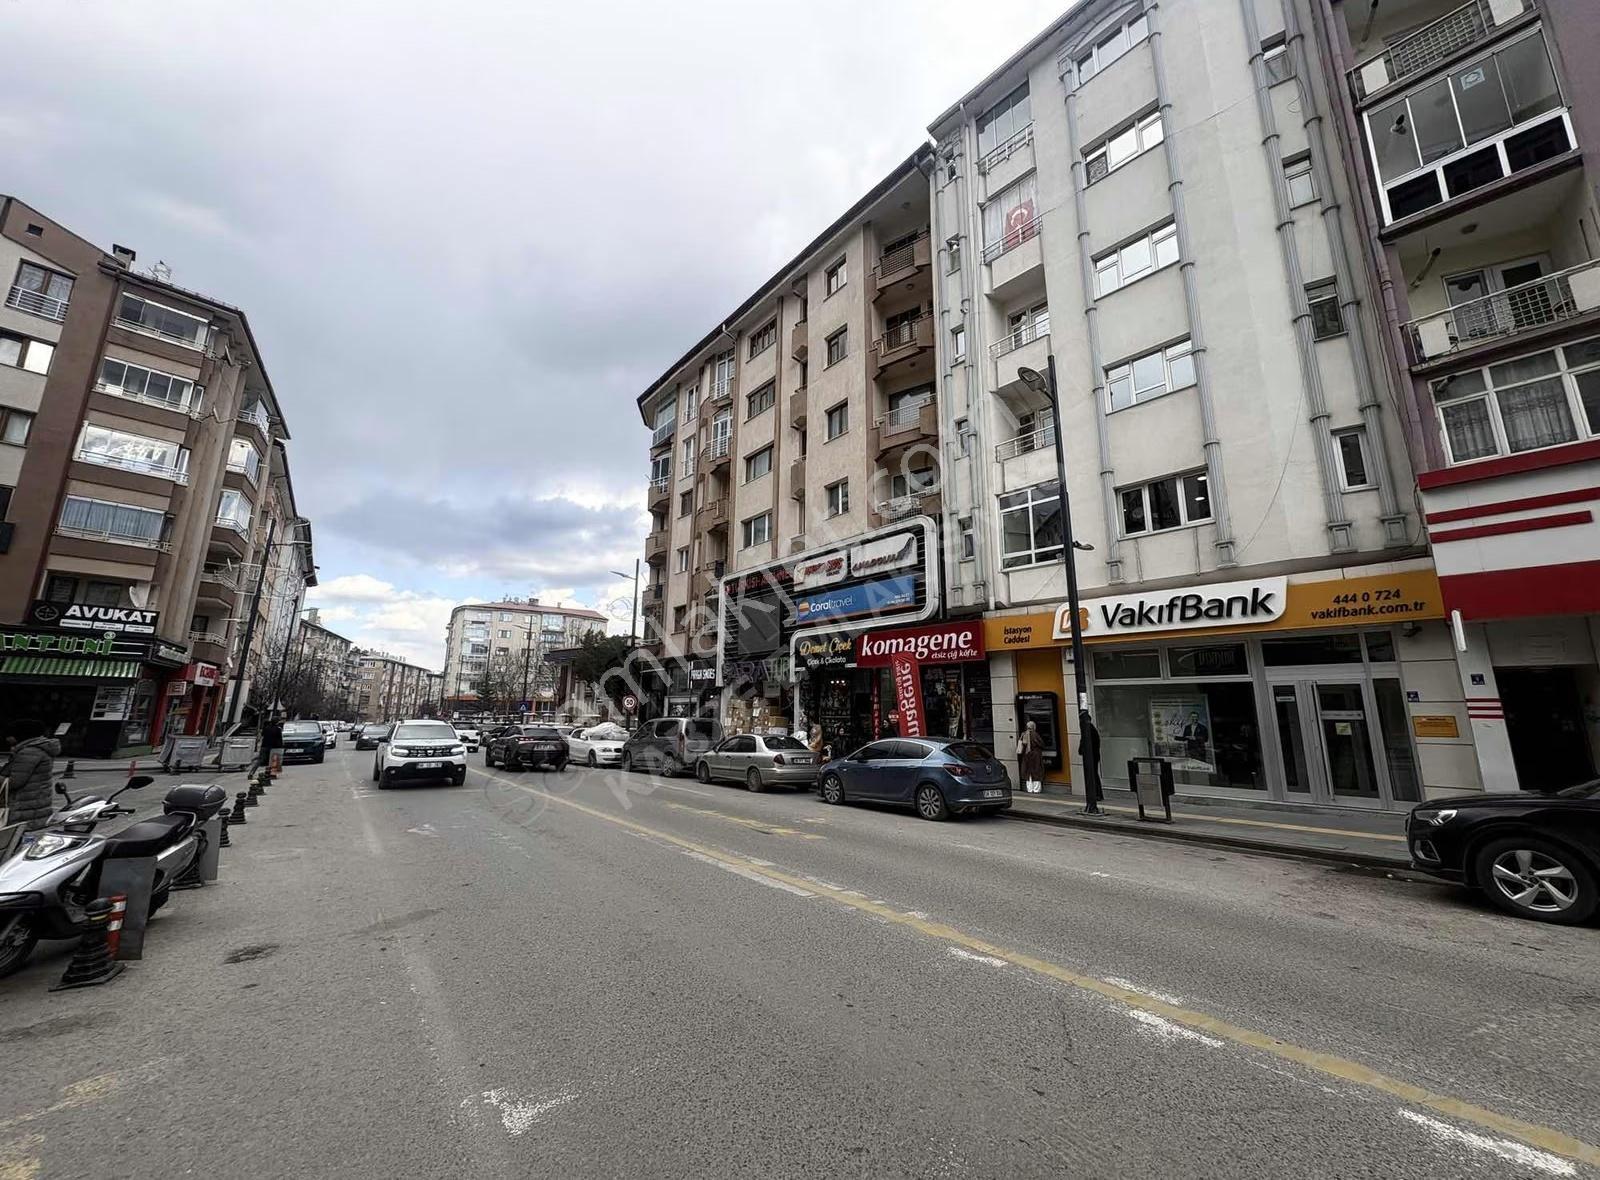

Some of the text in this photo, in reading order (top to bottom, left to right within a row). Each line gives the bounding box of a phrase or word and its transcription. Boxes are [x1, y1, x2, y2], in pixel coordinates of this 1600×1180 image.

[1332, 588, 1401, 605] 444 0 724
[65, 605, 157, 624] AVUKAT
[861, 630, 973, 660] komagene
[1003, 635, 1031, 644] Caddesi
